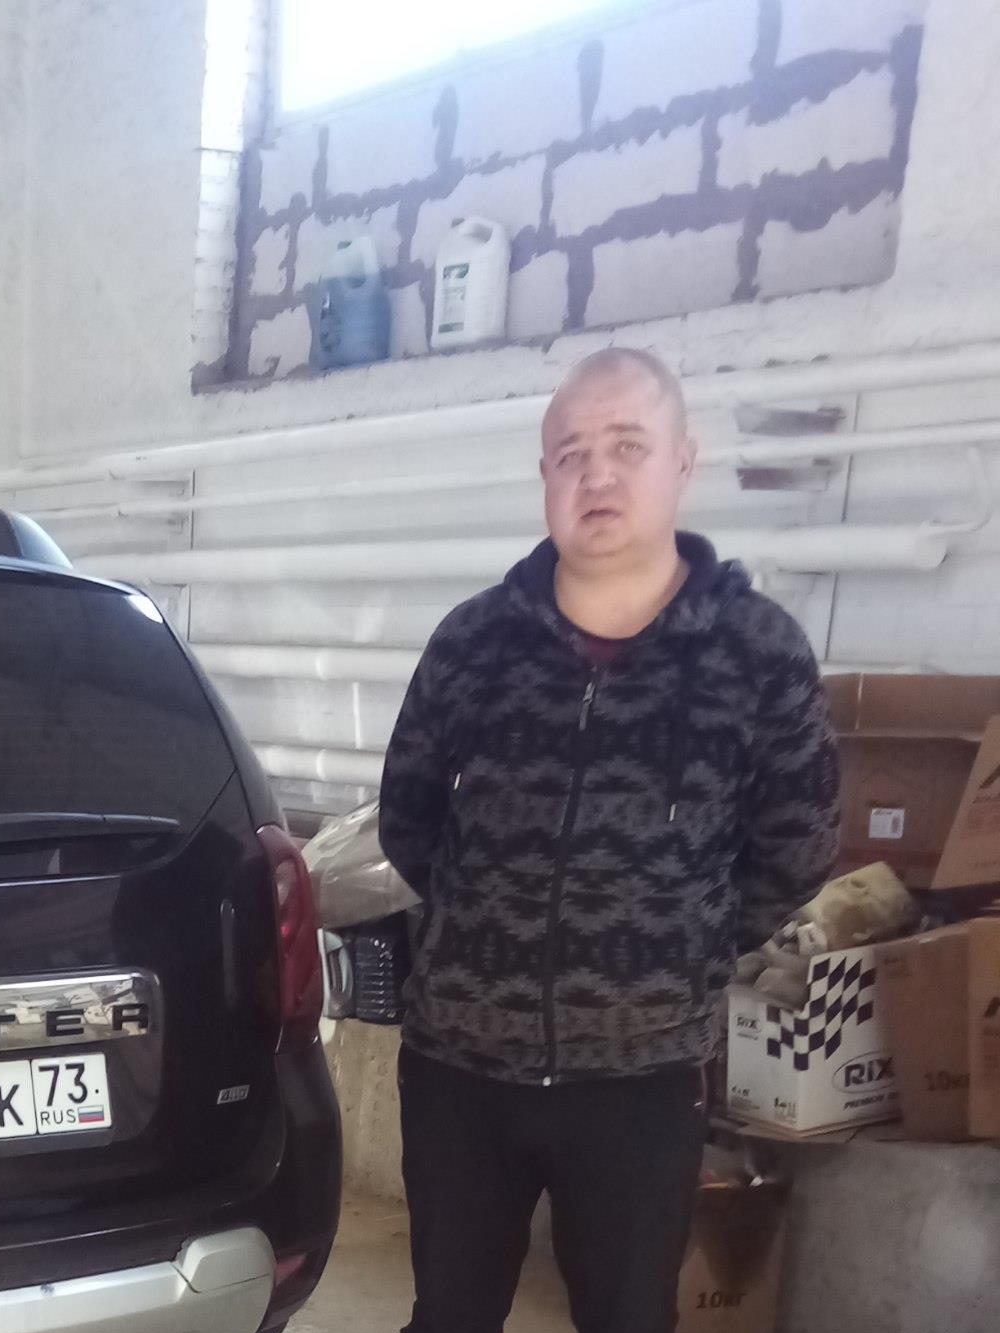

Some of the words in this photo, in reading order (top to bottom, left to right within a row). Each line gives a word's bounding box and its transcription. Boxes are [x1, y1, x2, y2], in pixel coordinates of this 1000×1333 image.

[38, 1063, 89, 1108] 73
[845, 1057, 895, 1087] RIX
[40, 1108, 77, 1127] RUS
